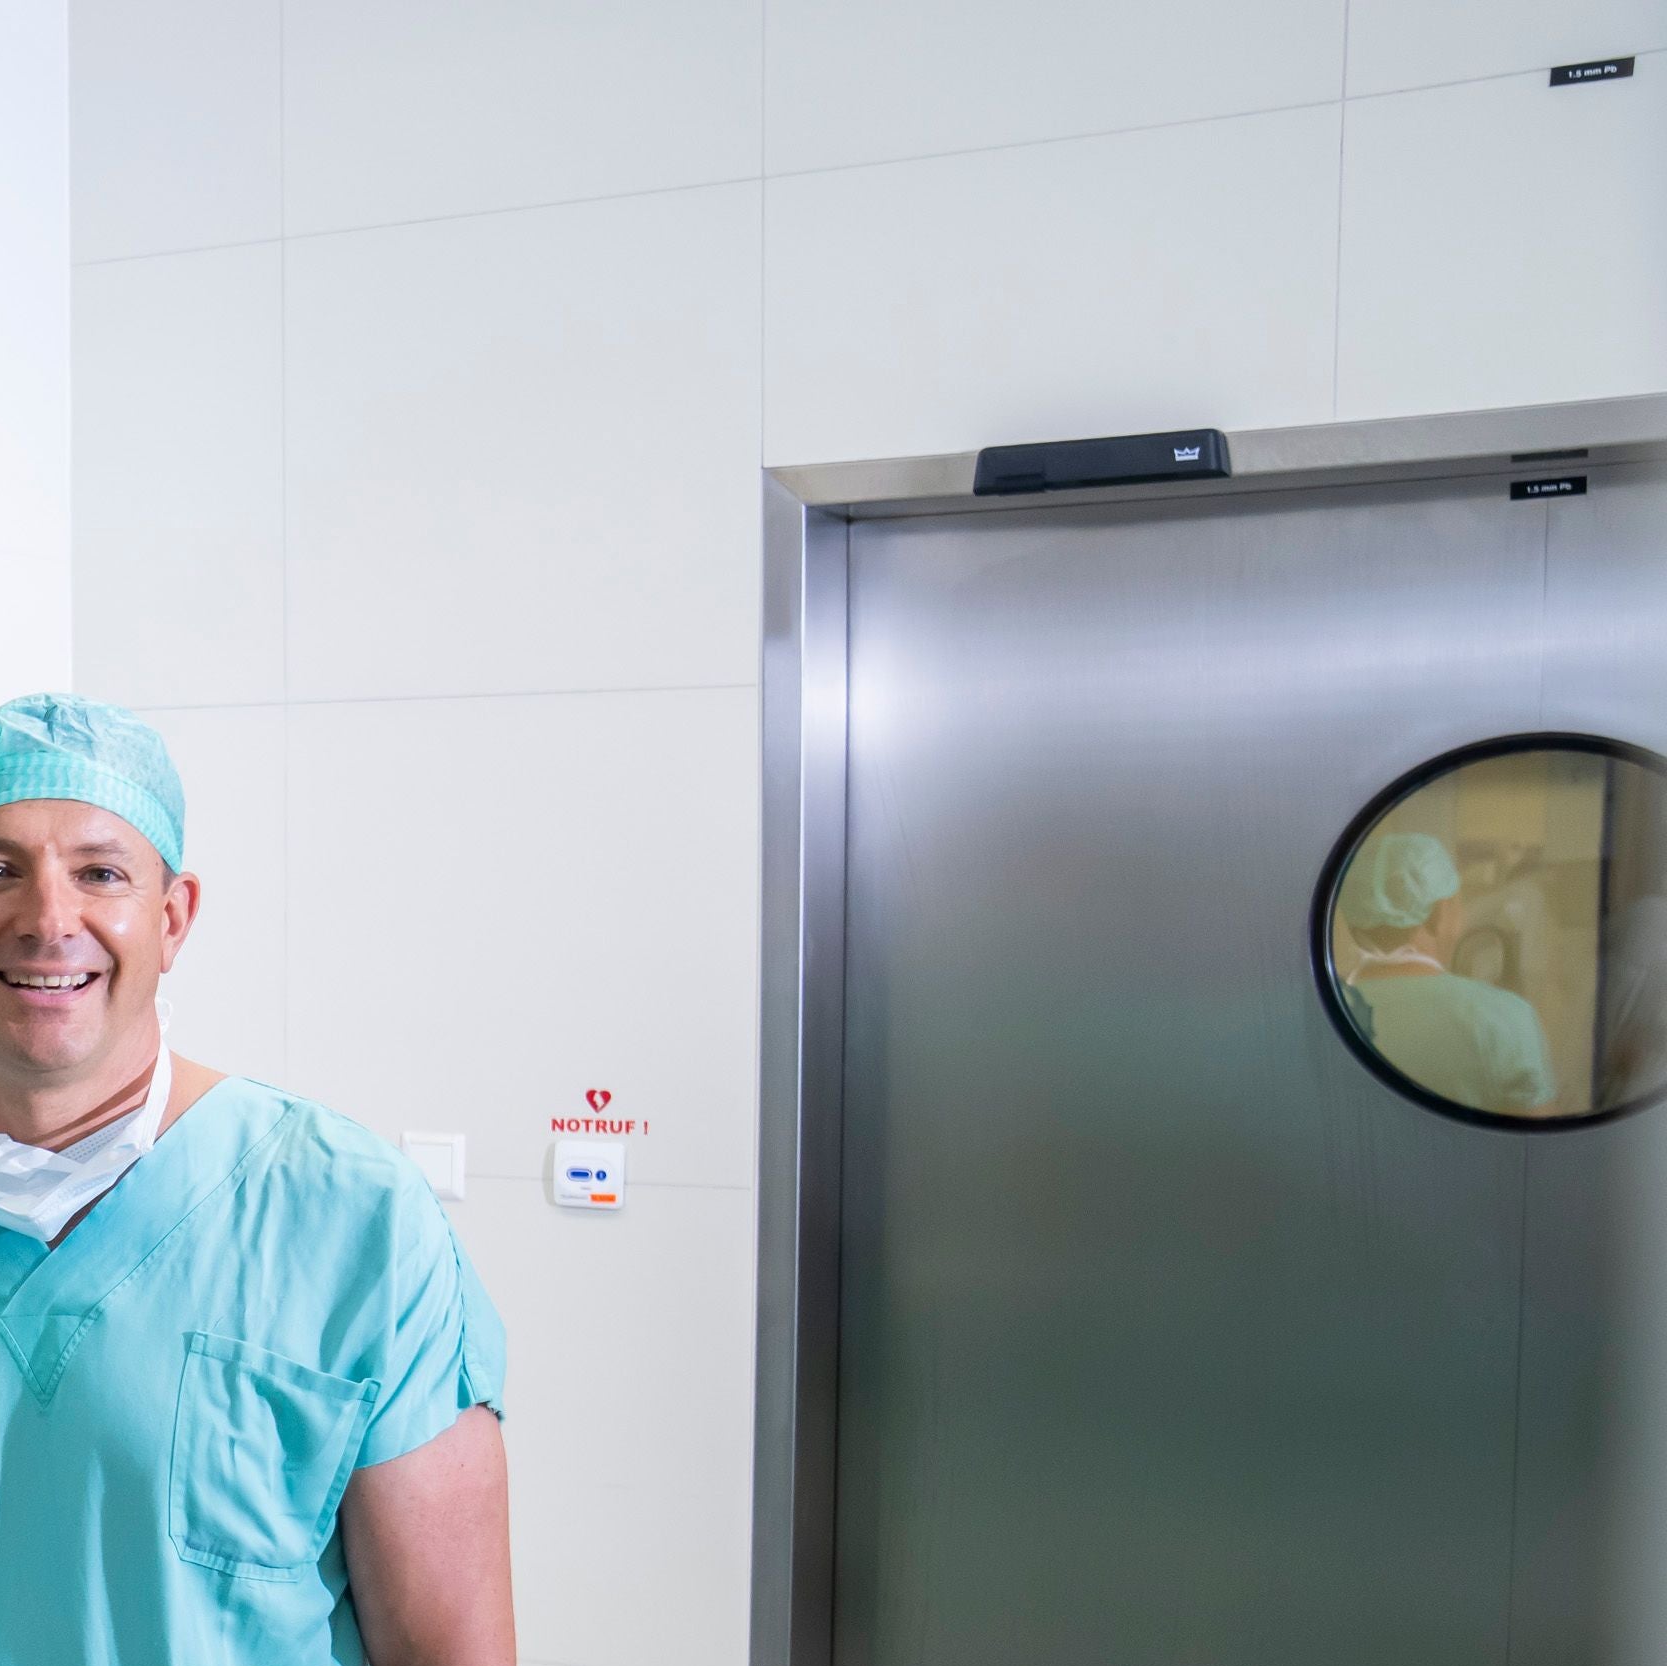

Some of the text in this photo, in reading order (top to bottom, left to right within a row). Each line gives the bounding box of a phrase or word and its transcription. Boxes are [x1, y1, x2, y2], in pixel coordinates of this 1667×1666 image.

[1583, 67, 1602, 77] mm
[1603, 65, 1618, 74] Pb
[1541, 484, 1558, 492] mm
[550, 1118, 635, 1135] NOTRUF
